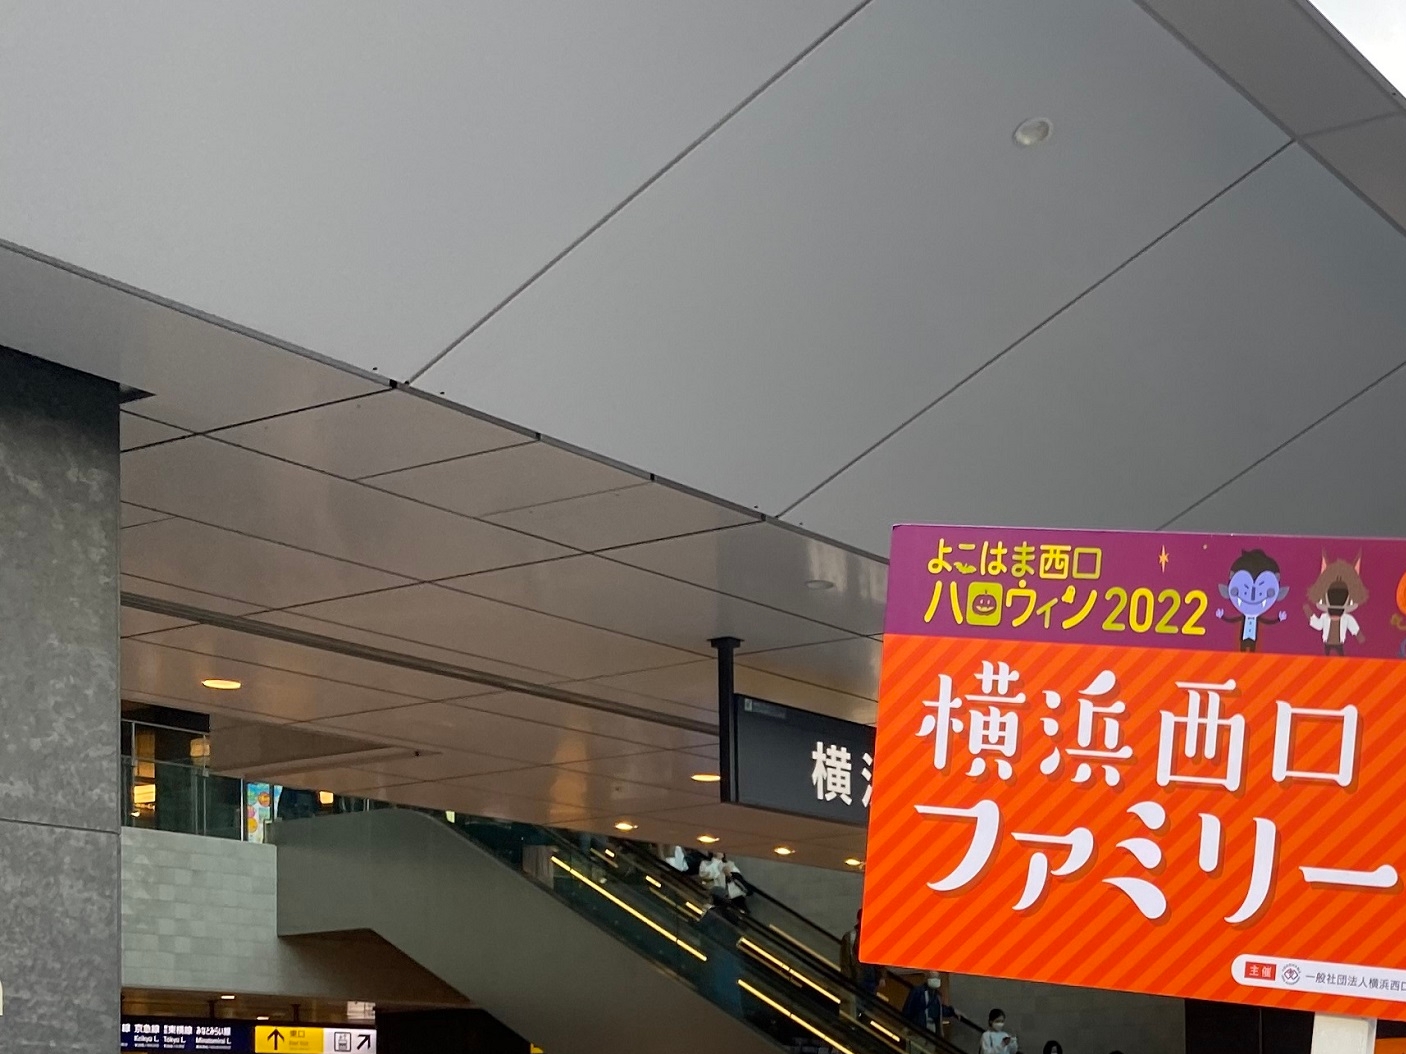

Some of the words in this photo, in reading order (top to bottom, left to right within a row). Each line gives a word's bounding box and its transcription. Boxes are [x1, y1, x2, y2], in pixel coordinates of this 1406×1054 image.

[927, 537, 1103, 580] よこはま西口
[914, 659, 1360, 793] 横浜西口
[1248, 964, 1272, 979] 主催
